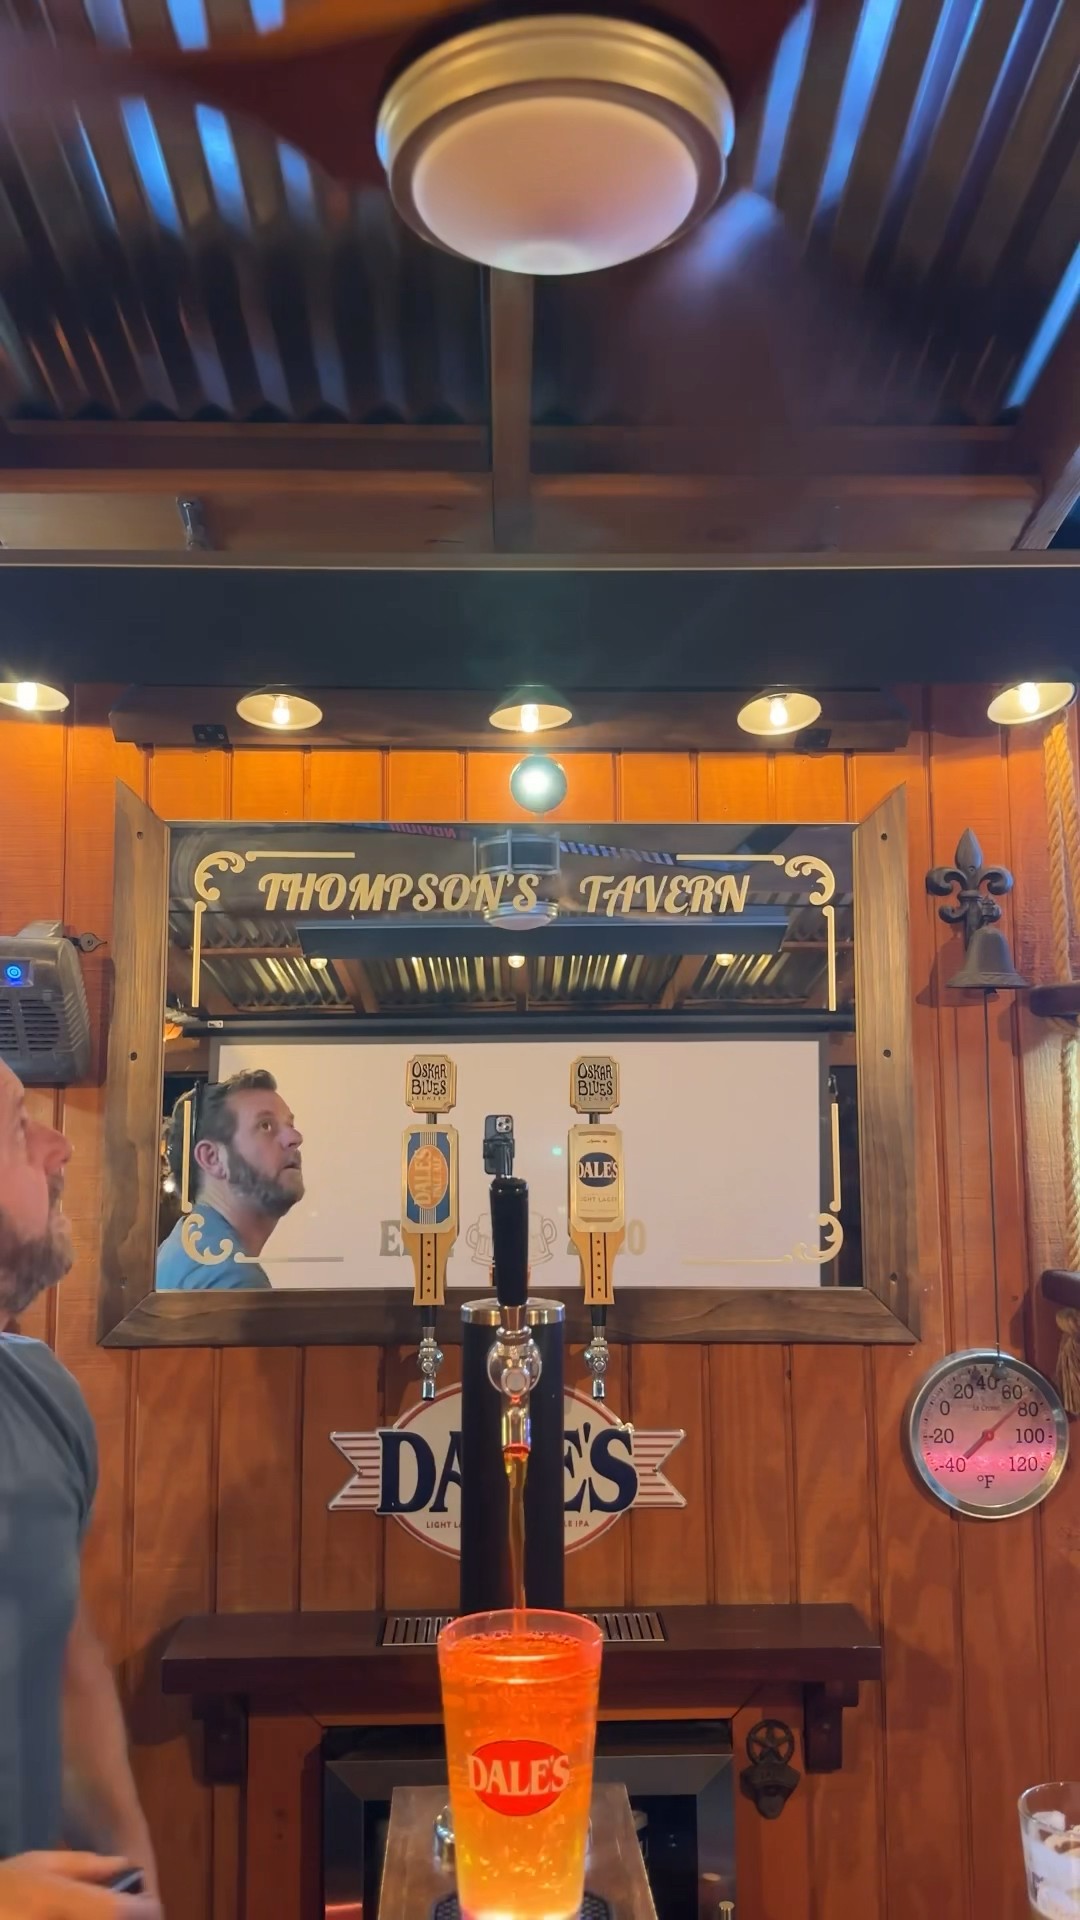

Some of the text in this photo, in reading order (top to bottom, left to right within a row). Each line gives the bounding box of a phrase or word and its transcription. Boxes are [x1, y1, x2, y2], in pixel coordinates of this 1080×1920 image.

[258, 872, 752, 916] THOMPSON'S TAVERN
[412, 1061, 447, 1080] OSKAR
[577, 1062, 613, 1081] OSKAR
[411, 1079, 447, 1096] BLUES
[578, 1080, 613, 1097] BLUES
[578, 1160, 619, 1179] DALE'S
[954, 1383, 975, 1400] 20
[976, 1376, 998, 1391] 40
[1001, 1384, 1023, 1400] 60
[940, 1401, 951, 1416] 0
[1018, 1401, 1039, 1417] 80
[1016, 1428, 1045, 1444] 100
[1009, 1456, 1038, 1473] 120
[426, 1521, 452, 1529] LIGHT
[575, 1520, 590, 1528] IPA
[467, 1755, 571, 1797] DALE'S
